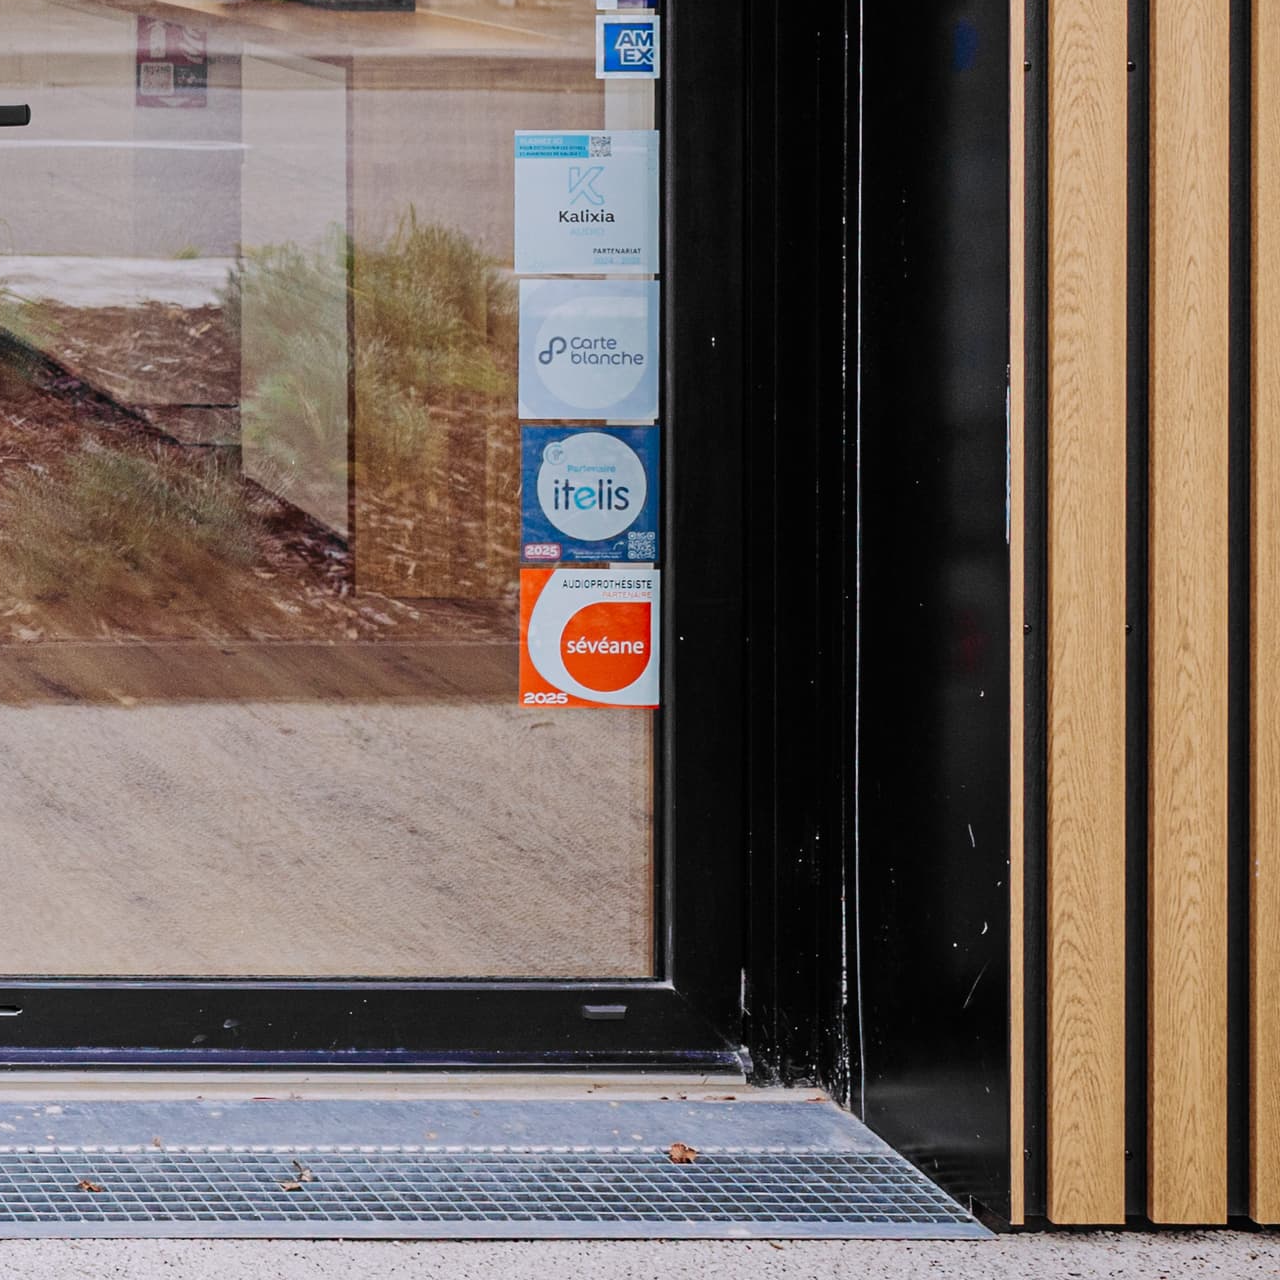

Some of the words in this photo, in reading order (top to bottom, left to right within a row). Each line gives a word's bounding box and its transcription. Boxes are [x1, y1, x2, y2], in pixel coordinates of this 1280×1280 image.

[558, 209, 615, 223] Kalixia
[570, 336, 617, 351] Carte
[570, 350, 644, 366] blanche
[553, 478, 630, 511] itelis
[525, 544, 559, 557] 2025
[602, 591, 652, 599] PARTENAIRE
[566, 636, 644, 655] sévéane
[523, 692, 569, 704] 2025
